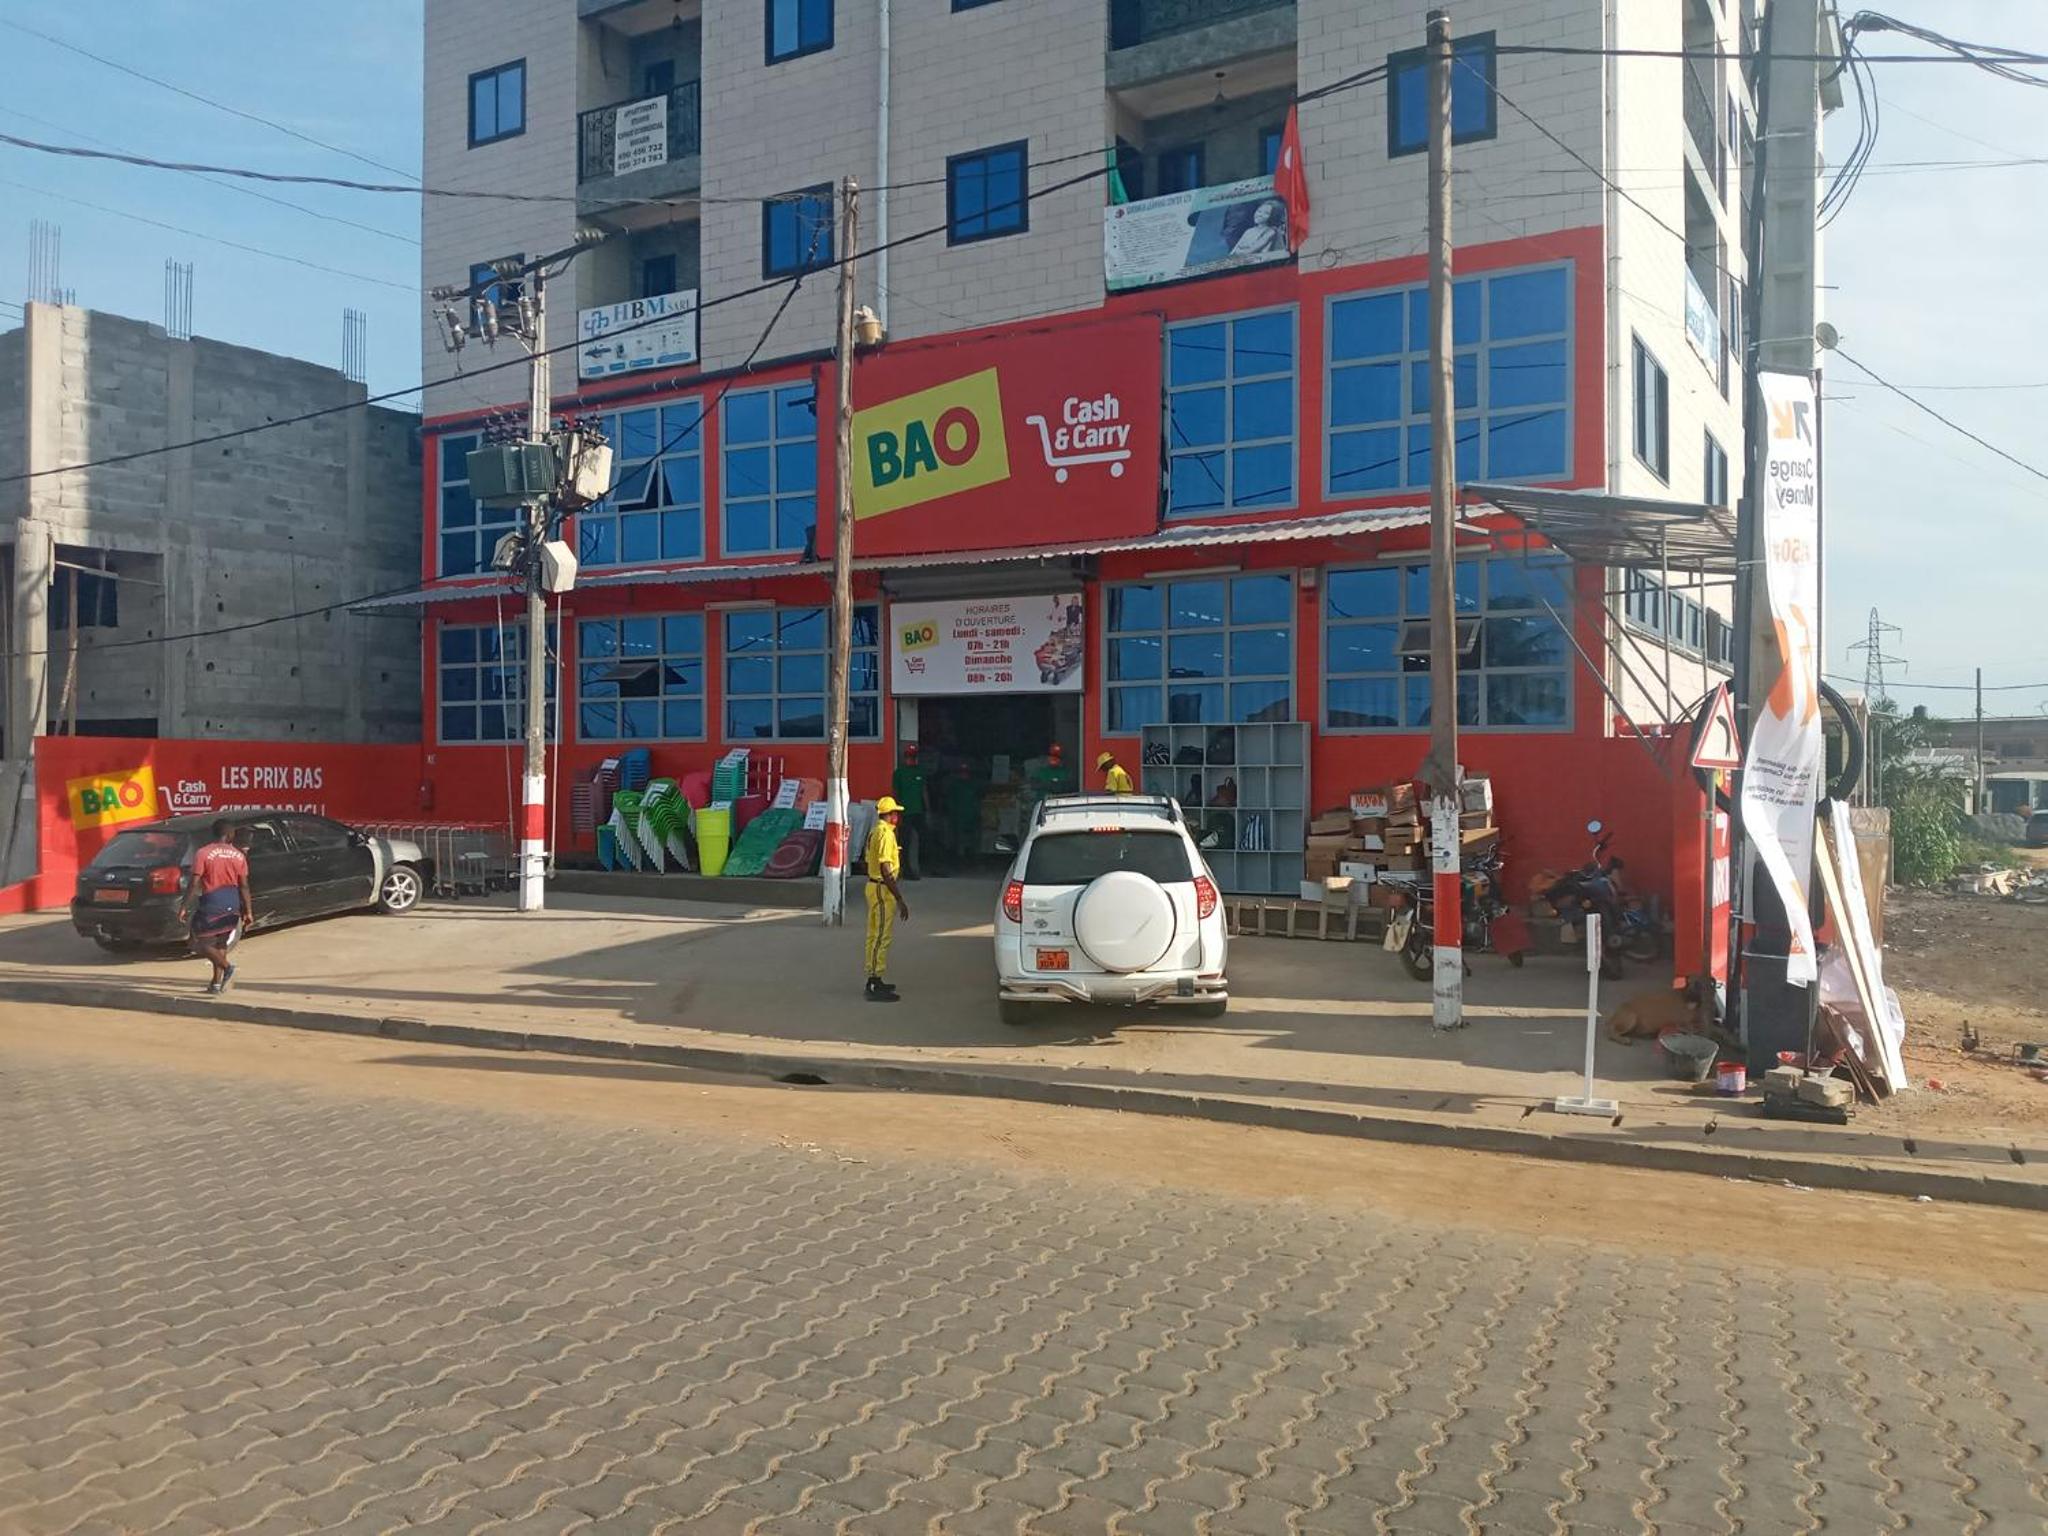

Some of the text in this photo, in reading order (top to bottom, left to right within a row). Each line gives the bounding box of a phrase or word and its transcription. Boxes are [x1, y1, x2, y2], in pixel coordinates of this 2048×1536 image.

[613, 297, 667, 321] HBM
[1063, 393, 1119, 425] Cash
[867, 406, 980, 488] BAO
[1055, 424, 1131, 450] & Carry
[966, 604, 1011, 615] HORAIRES
[904, 627, 933, 646] BAO
[953, 628, 977, 639] Lundi
[985, 627, 1021, 637] samedi
[965, 654, 1013, 666] Dimanche
[178, 780, 206, 793] Cash
[221, 767, 322, 789] LES PRIX BAS
[81, 779, 144, 815] BAO
[174, 793, 212, 806] & Carry
